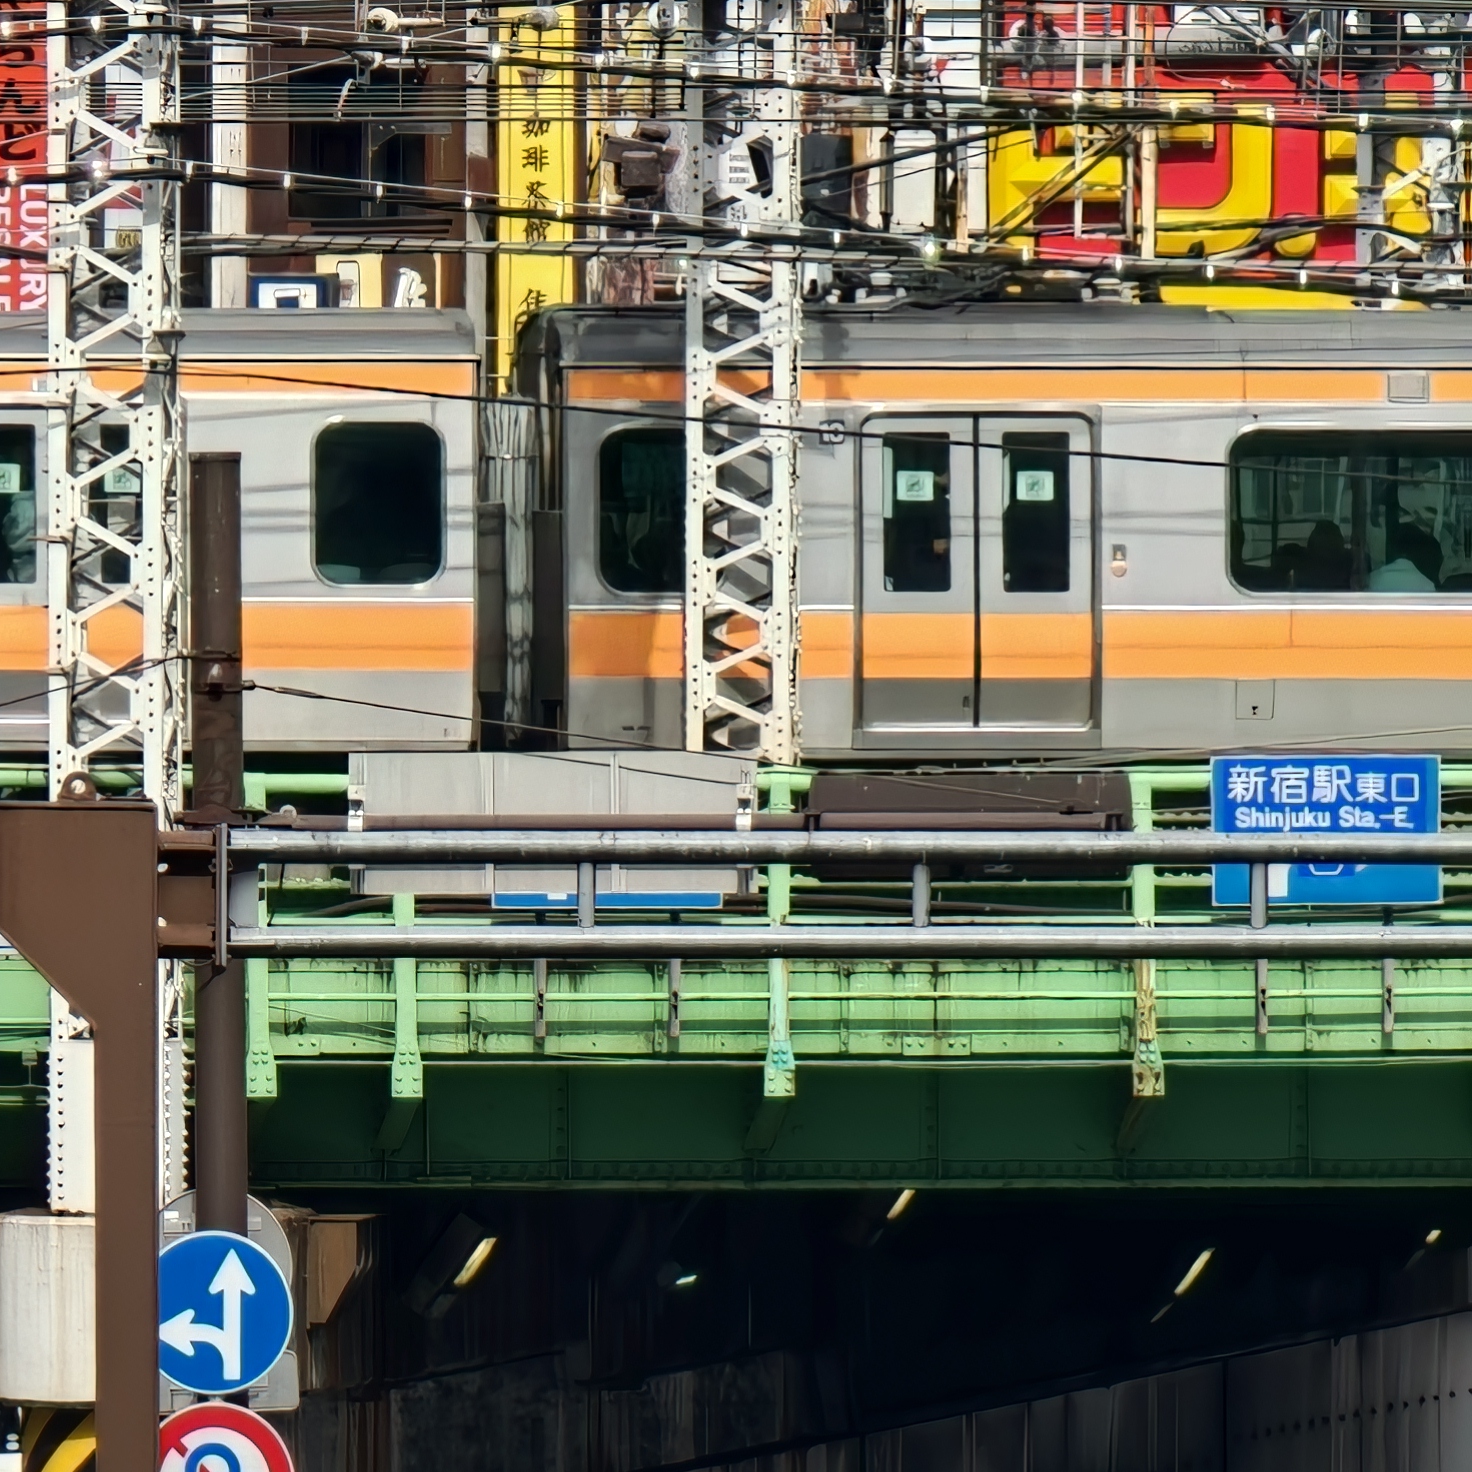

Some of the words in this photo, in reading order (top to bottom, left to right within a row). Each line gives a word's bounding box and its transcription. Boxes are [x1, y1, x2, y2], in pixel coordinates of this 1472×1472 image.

[18, 184, 49, 312] LUXURY
[1227, 764, 1420, 804] 新宿駅東口
[1235, 806, 1331, 832] Shinjuku
